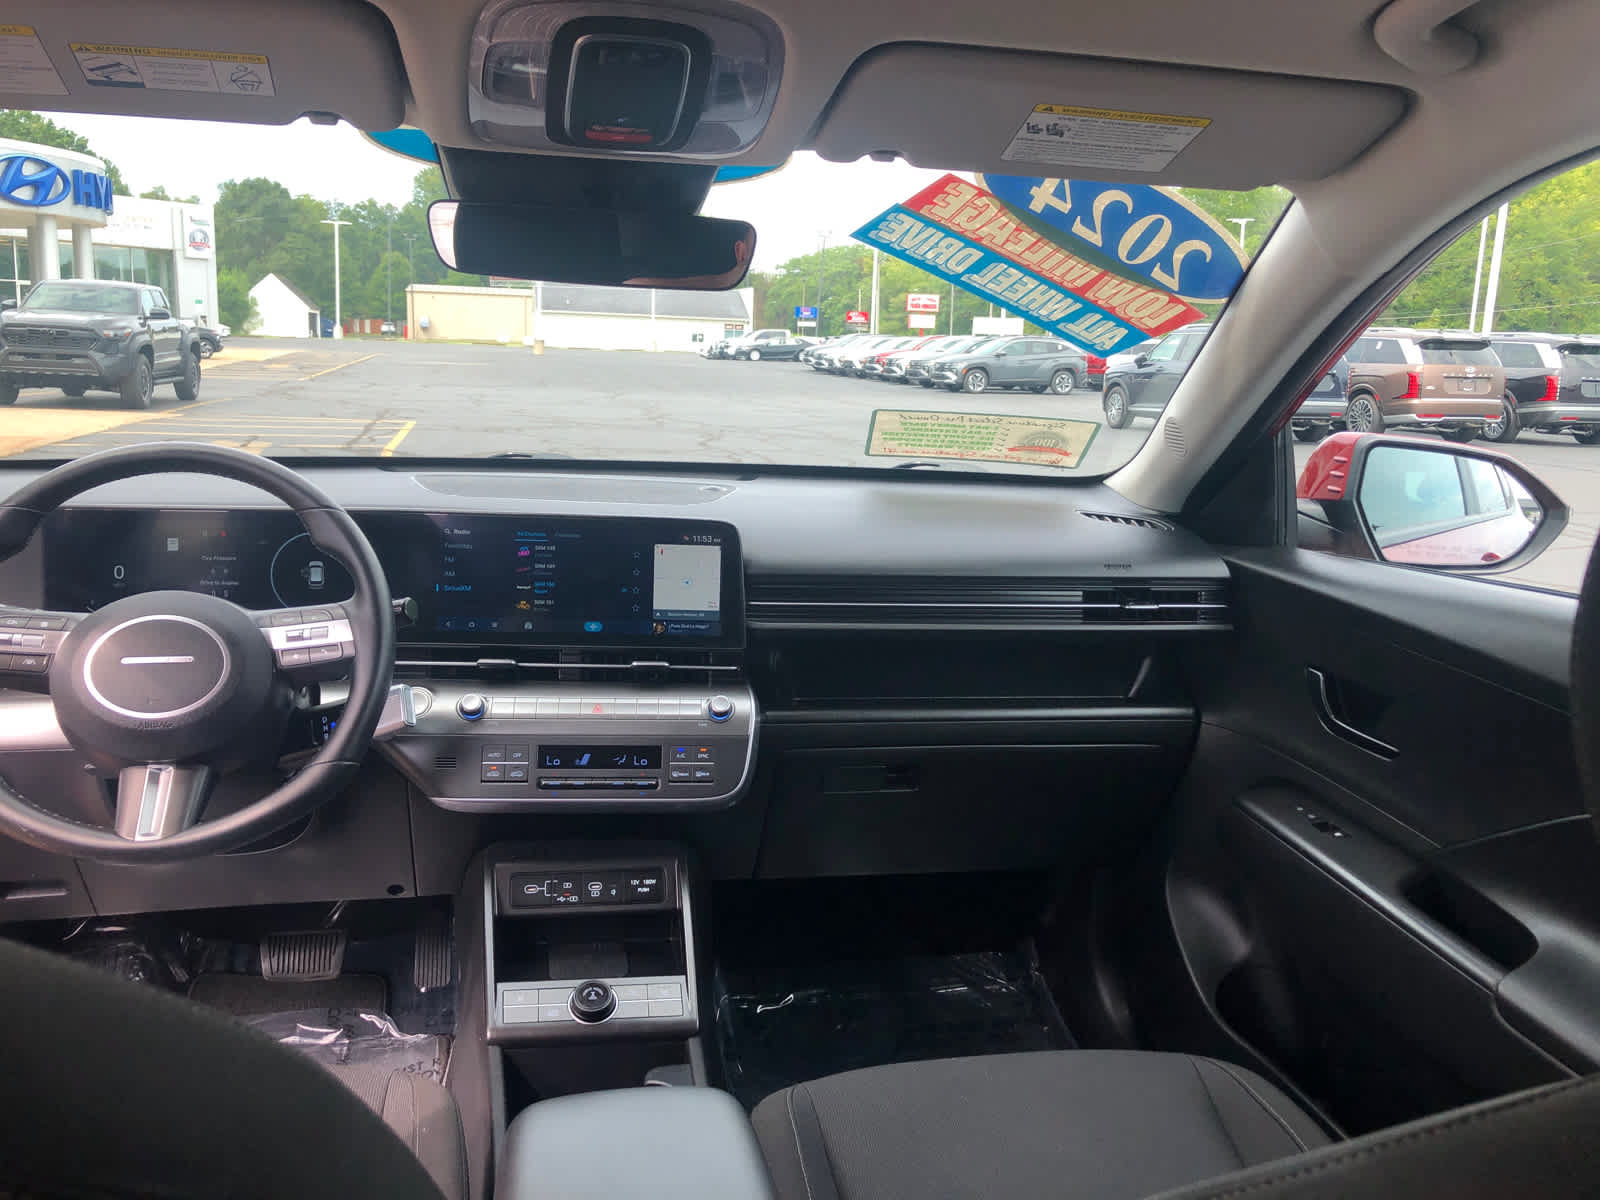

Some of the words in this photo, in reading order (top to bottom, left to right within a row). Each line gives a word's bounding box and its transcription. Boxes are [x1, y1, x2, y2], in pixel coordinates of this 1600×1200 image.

[113, 565, 125, 580] 0
[545, 755, 561, 766] Lo
[633, 755, 648, 766] Lo
